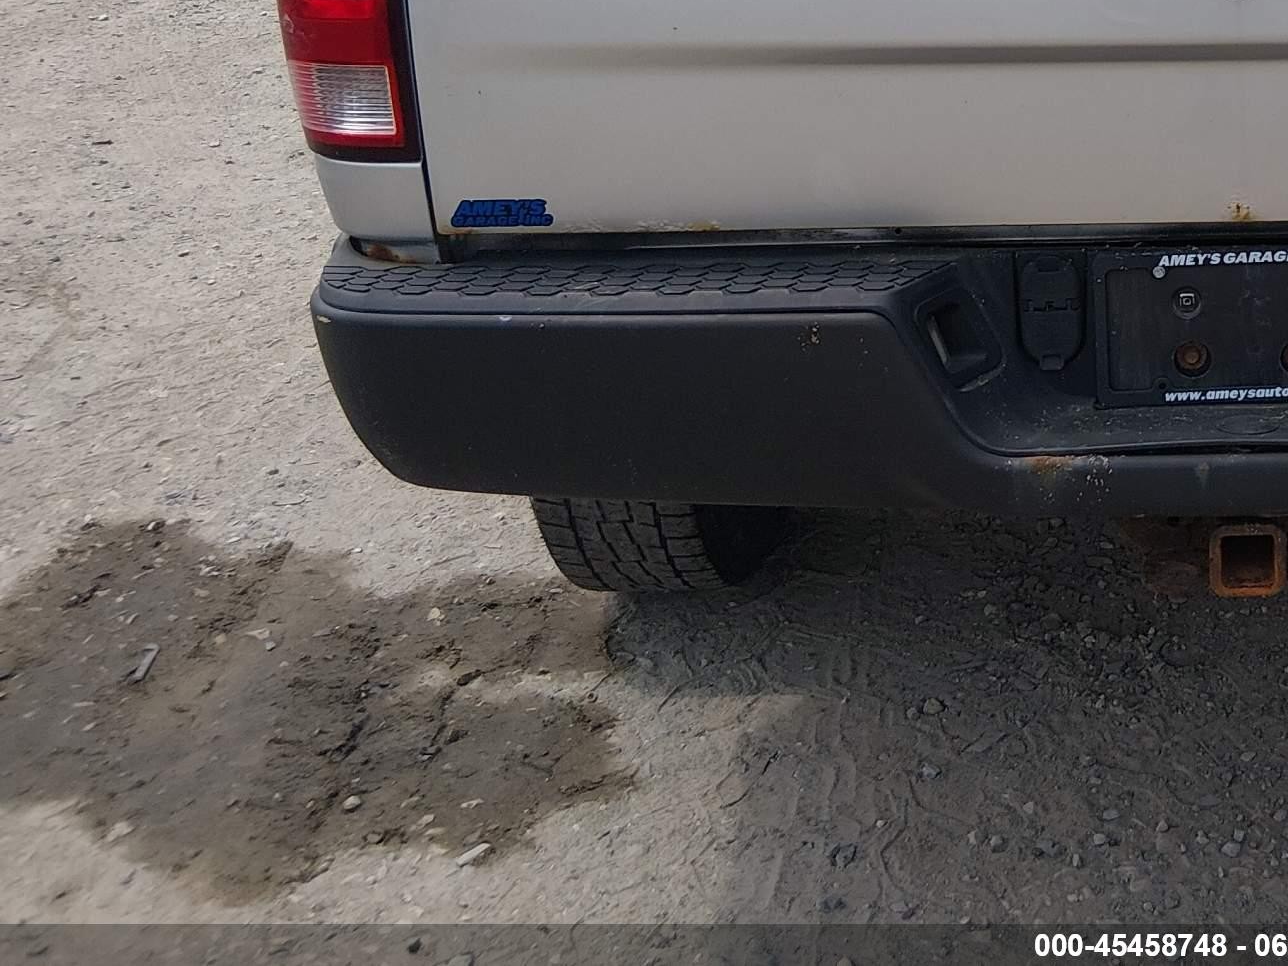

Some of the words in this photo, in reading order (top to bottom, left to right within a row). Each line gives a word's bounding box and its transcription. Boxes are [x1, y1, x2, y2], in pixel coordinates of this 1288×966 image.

[456, 200, 546, 215] AMEY'S
[453, 216, 519, 227] GARAGE
[524, 215, 552, 226] INC
[1159, 253, 1220, 266] AMEY'S
